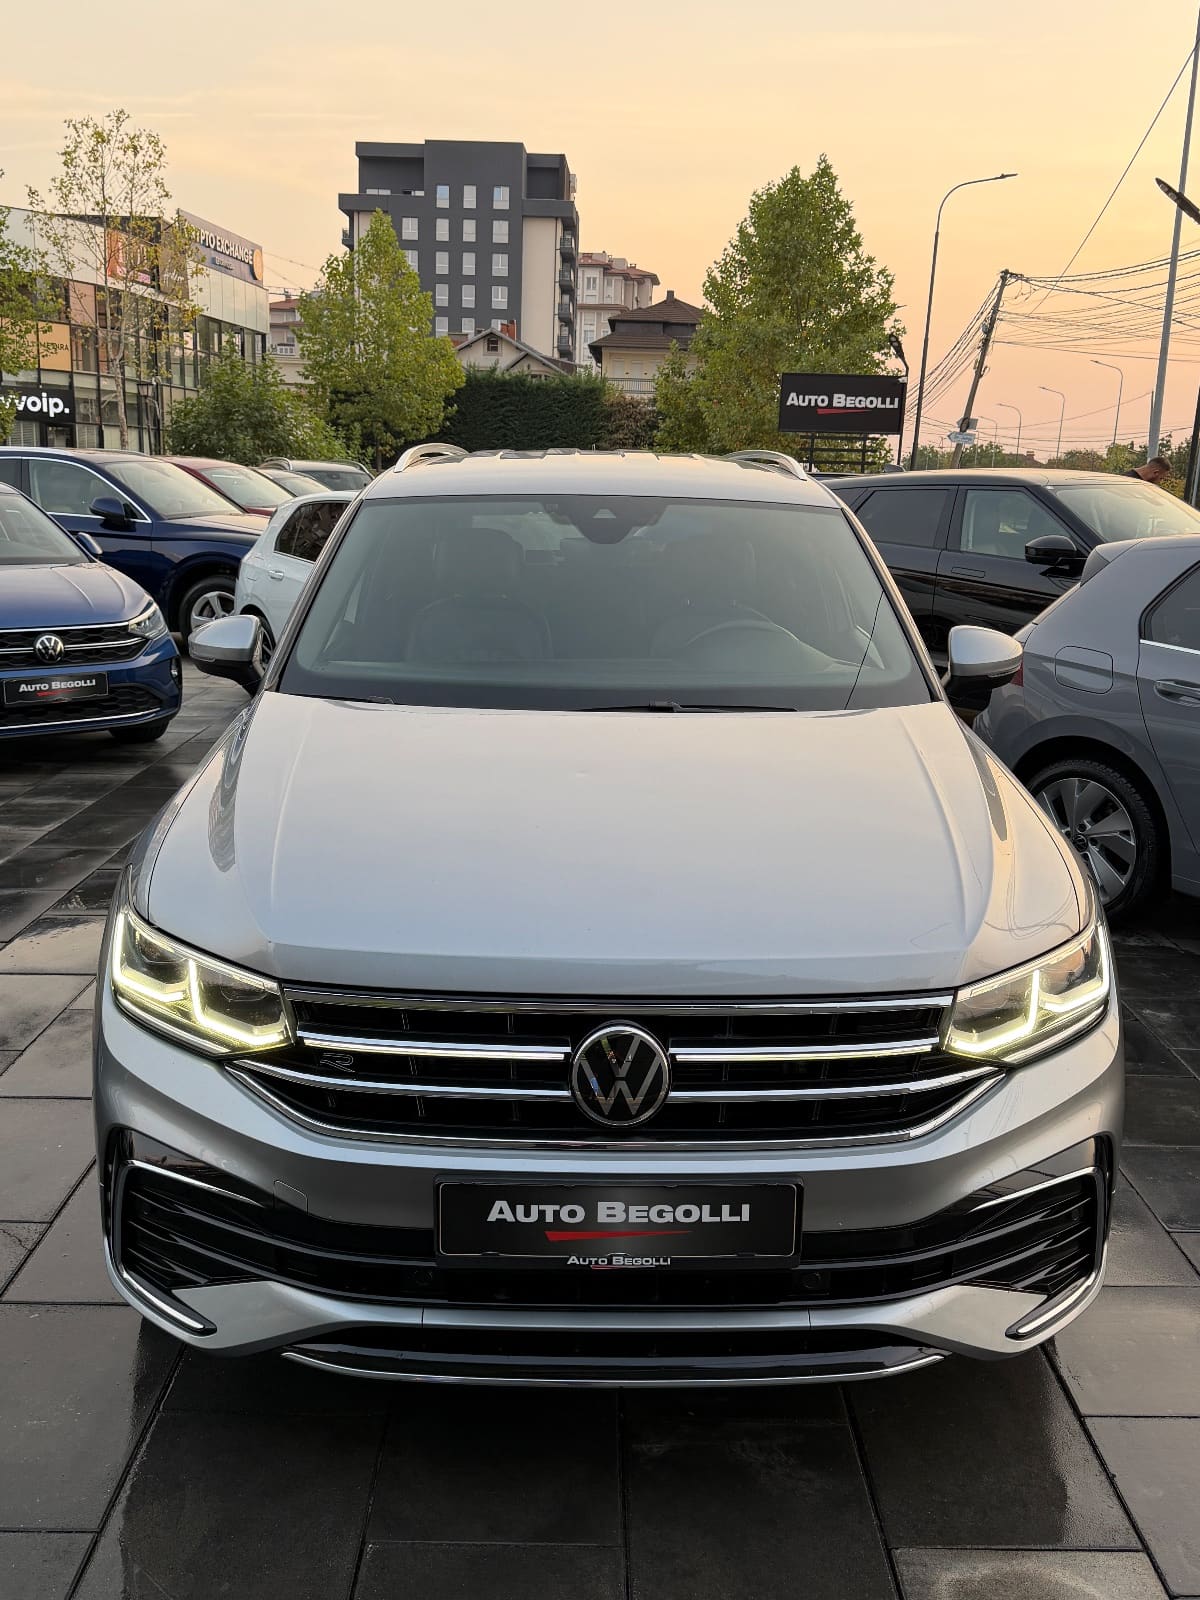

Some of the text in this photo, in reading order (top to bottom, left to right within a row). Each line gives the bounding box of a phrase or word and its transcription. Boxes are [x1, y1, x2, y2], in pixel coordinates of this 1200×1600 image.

[216, 235, 253, 265] EXCHANGE
[786, 392, 899, 409] AUTO BEGOLLI
[19, 679, 96, 692] AUTO BEGOLLI
[486, 1200, 750, 1223] AUTO BEGOLLI
[567, 1256, 671, 1265] AUTO BEGOLLI
